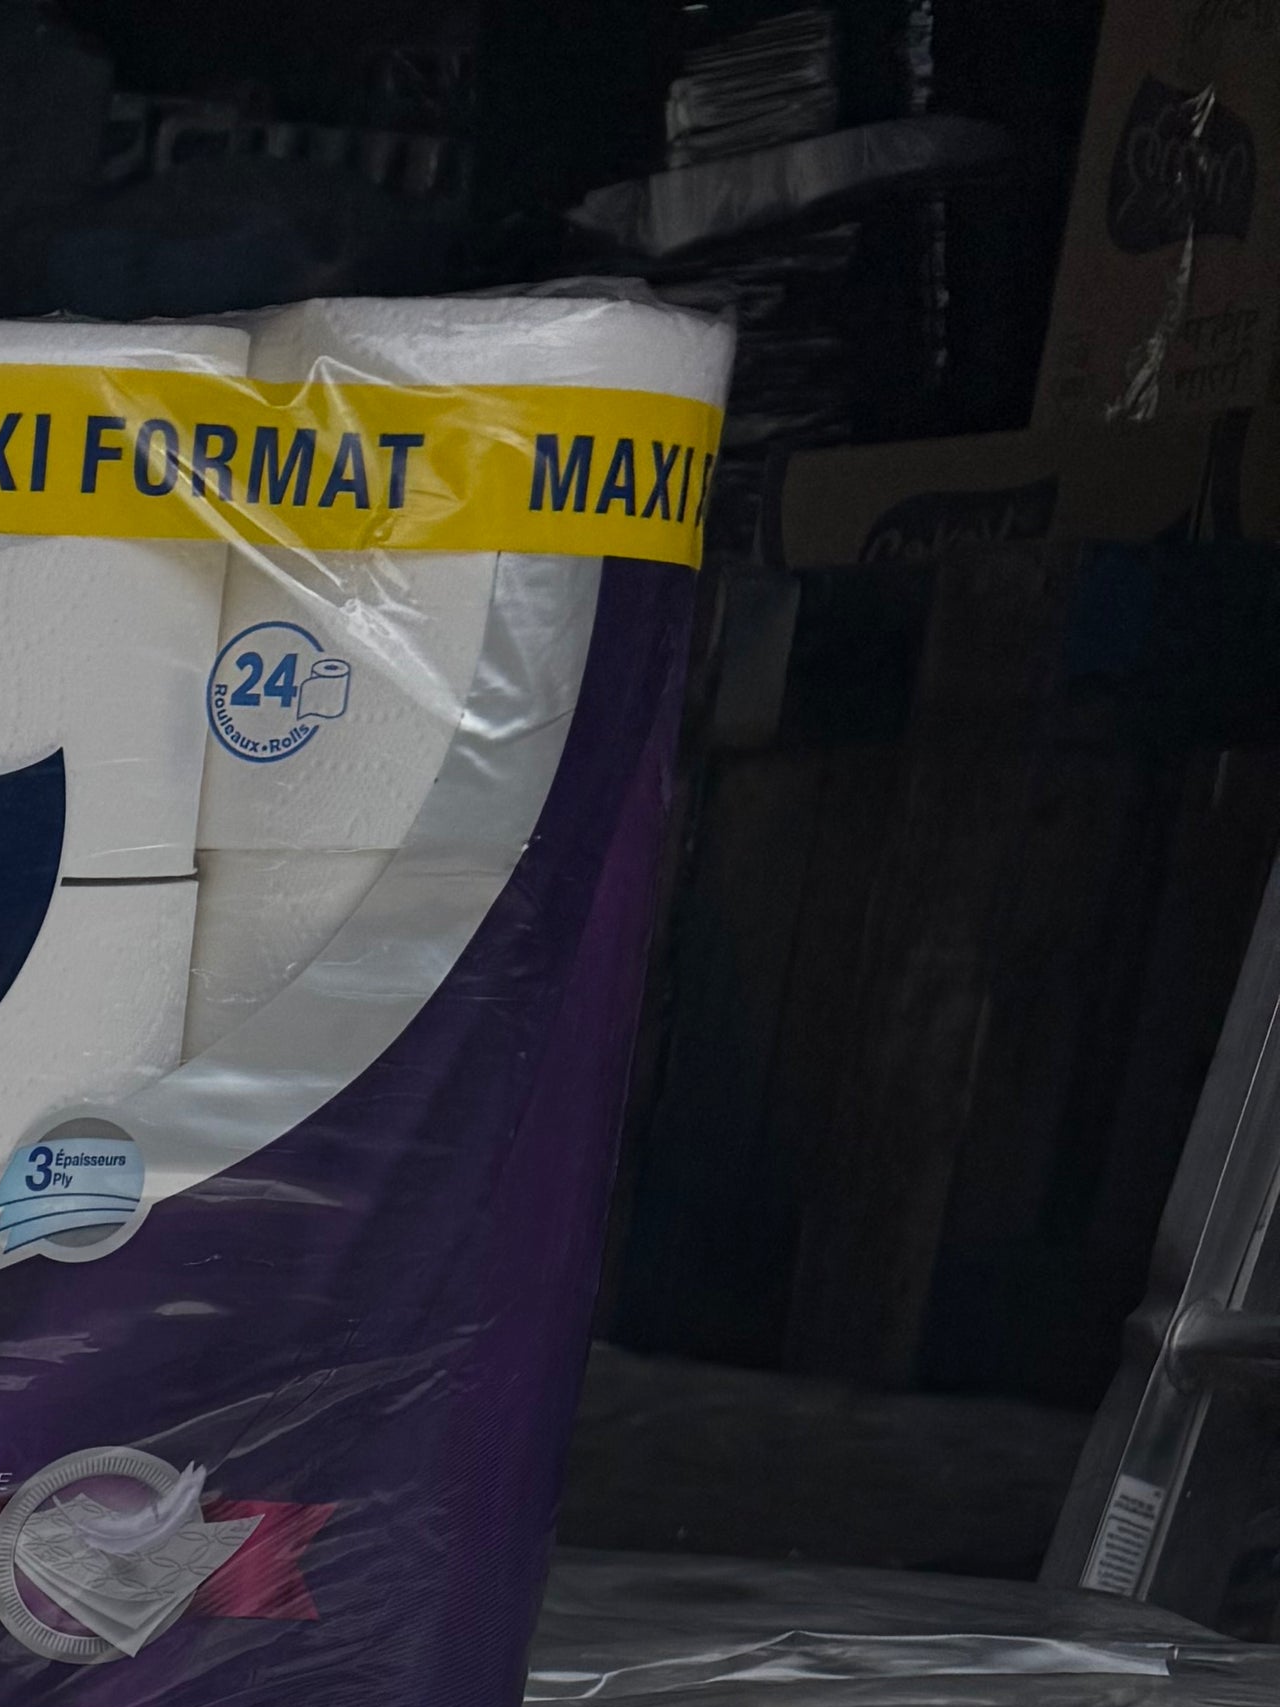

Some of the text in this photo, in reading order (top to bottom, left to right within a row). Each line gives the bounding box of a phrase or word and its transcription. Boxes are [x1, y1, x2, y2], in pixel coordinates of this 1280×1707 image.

[81, 416, 425, 509] FORMAT
[528, 432, 696, 523] MAXI
[230, 651, 299, 708] 24
[25, 1145, 127, 1192] 3 Épaisseurs
[52, 1171, 74, 1189] Ply
